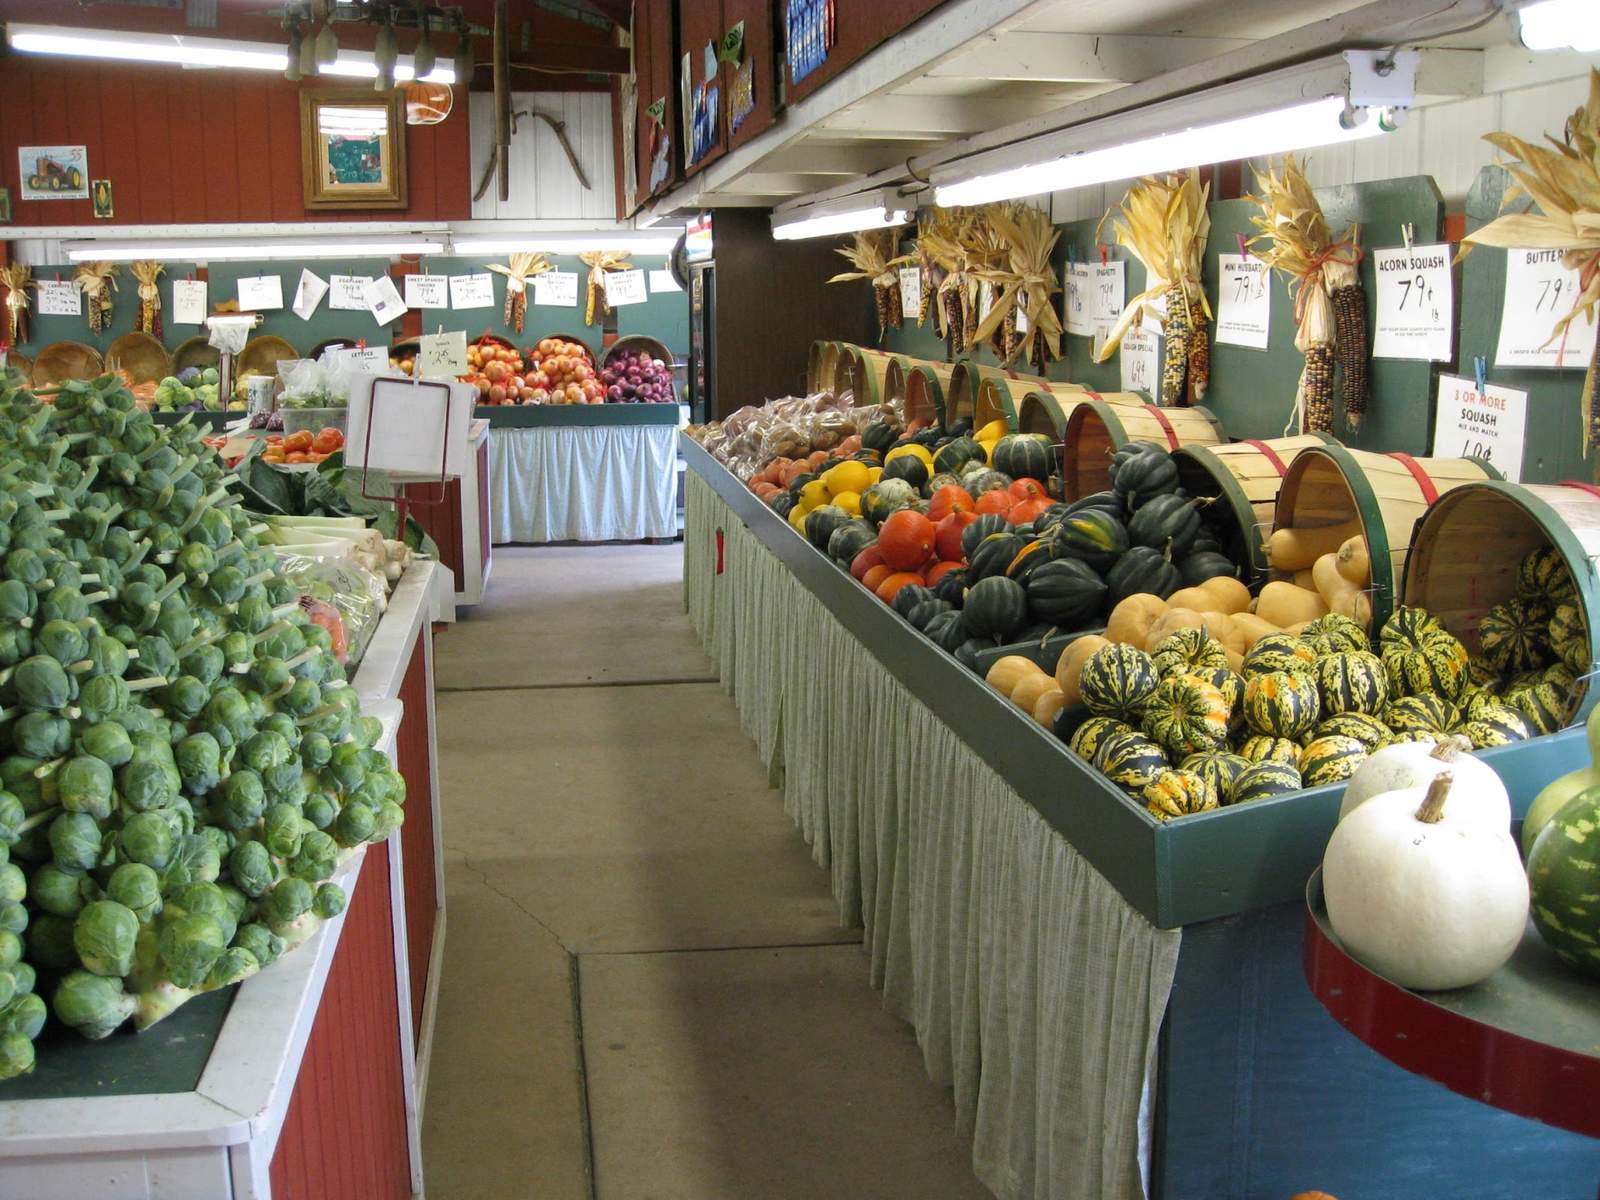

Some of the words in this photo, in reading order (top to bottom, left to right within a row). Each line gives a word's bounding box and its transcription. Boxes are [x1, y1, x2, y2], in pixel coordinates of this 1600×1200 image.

[1379, 260, 1407, 271] ACORN
[1410, 257, 1444, 270] SQUASH
[1455, 390, 1460, 401] 3
[1463, 391, 1475, 405] OR
[1480, 394, 1506, 411] MORE
[1461, 408, 1497, 426] SQUASH
[1481, 429, 1499, 438] MATCH
